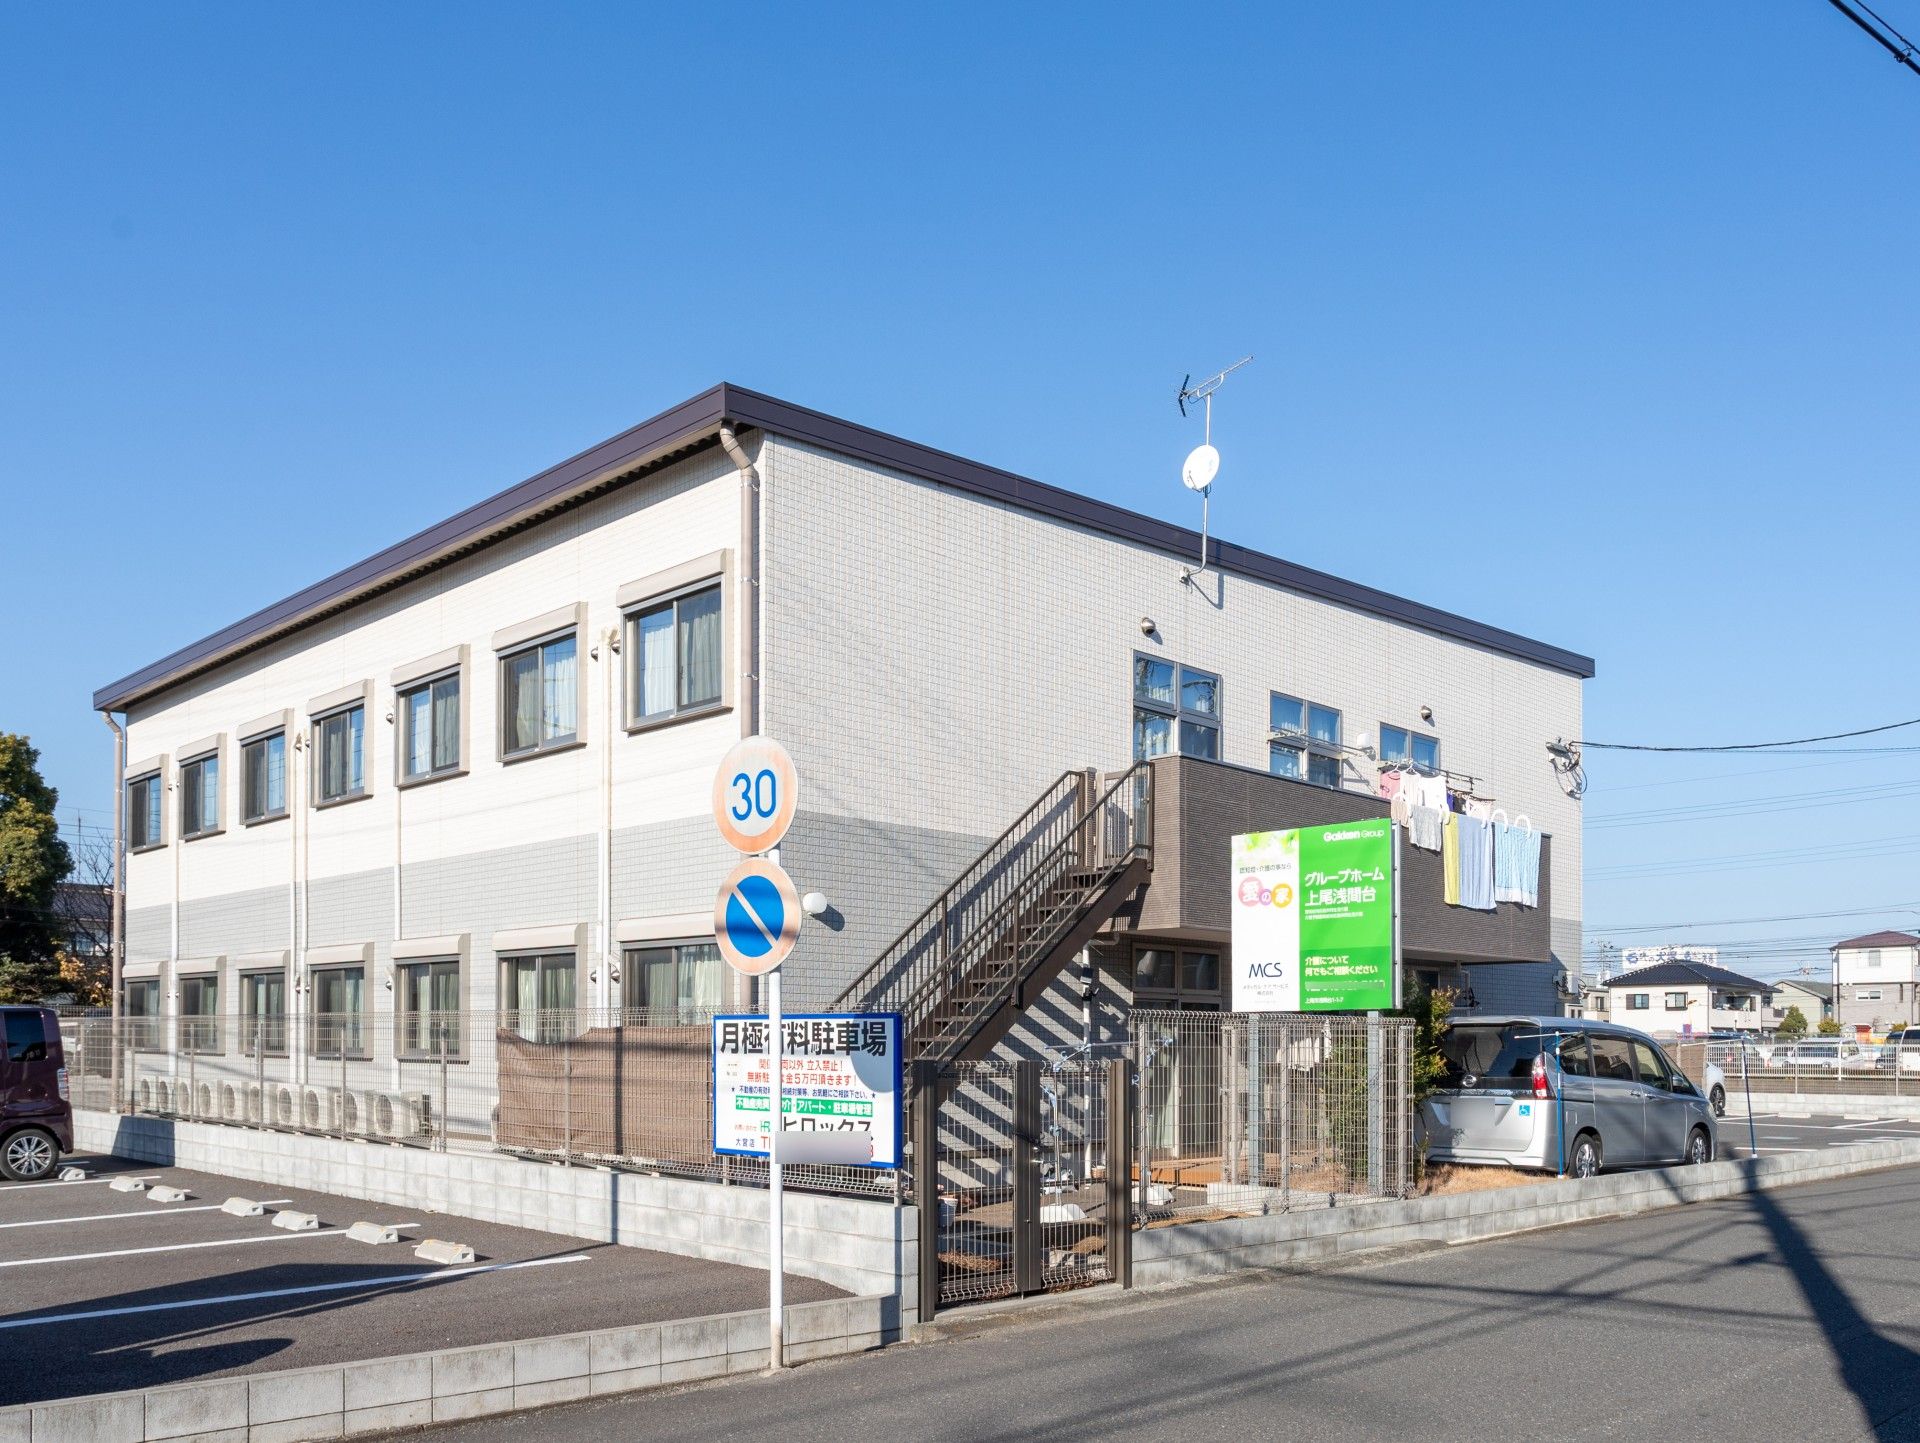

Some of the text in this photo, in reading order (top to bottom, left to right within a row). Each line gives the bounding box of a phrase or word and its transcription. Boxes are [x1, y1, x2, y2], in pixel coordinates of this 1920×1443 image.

[732, 769, 777, 821] 30
[1305, 866, 1385, 887] グループホーム
[1305, 885, 1376, 906] 上尾浅間台
[1305, 955, 1349, 966] 介護について
[1248, 962, 1283, 979] MCS
[1305, 965, 1378, 977] 何でもご相談ください
